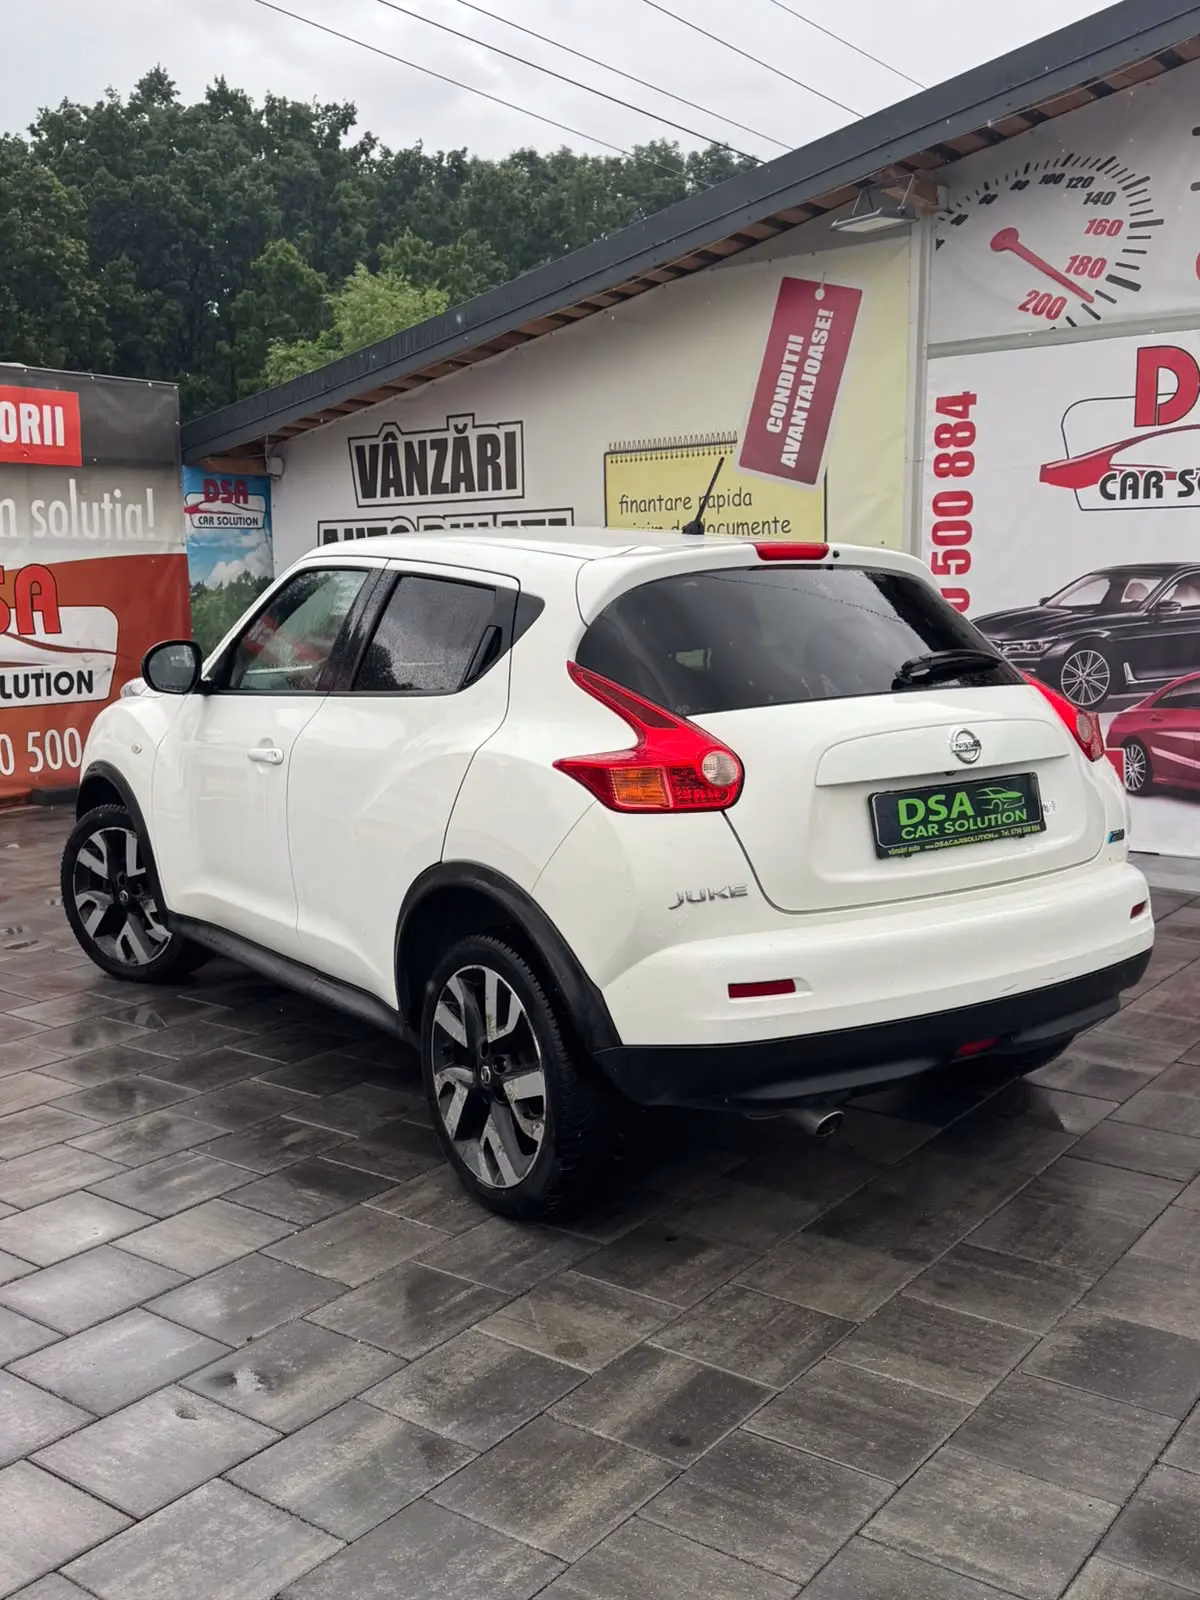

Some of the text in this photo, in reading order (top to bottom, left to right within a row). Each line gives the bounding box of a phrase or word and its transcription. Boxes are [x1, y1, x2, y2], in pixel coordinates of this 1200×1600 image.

[1038, 173, 1066, 185] 100
[1065, 175, 1095, 189] 120
[1083, 191, 1117, 206] 140
[1084, 218, 1124, 237] 160
[1064, 254, 1108, 279] 180
[1017, 289, 1068, 321] 200
[766, 334, 804, 433] CONDITII
[780, 308, 834, 468] AVANTAJOASE!
[0, 401, 65, 447] ORII
[933, 391, 977, 478] 884
[355, 423, 518, 499] VÂNZĂRI
[203, 478, 249, 504] DSA
[1100, 469, 1200, 500] CAR S
[31, 478, 156, 541] solutia!
[198, 515, 259, 526] CAR SOLUTION
[619, 494, 693, 519] finantare
[931, 490, 973, 576] 500
[0, 563, 62, 636] A
[27, 727, 83, 774] 500
[897, 792, 976, 826] DSA
[901, 808, 1028, 840] CAR SOLUTION
[668, 883, 748, 910] JUKE
